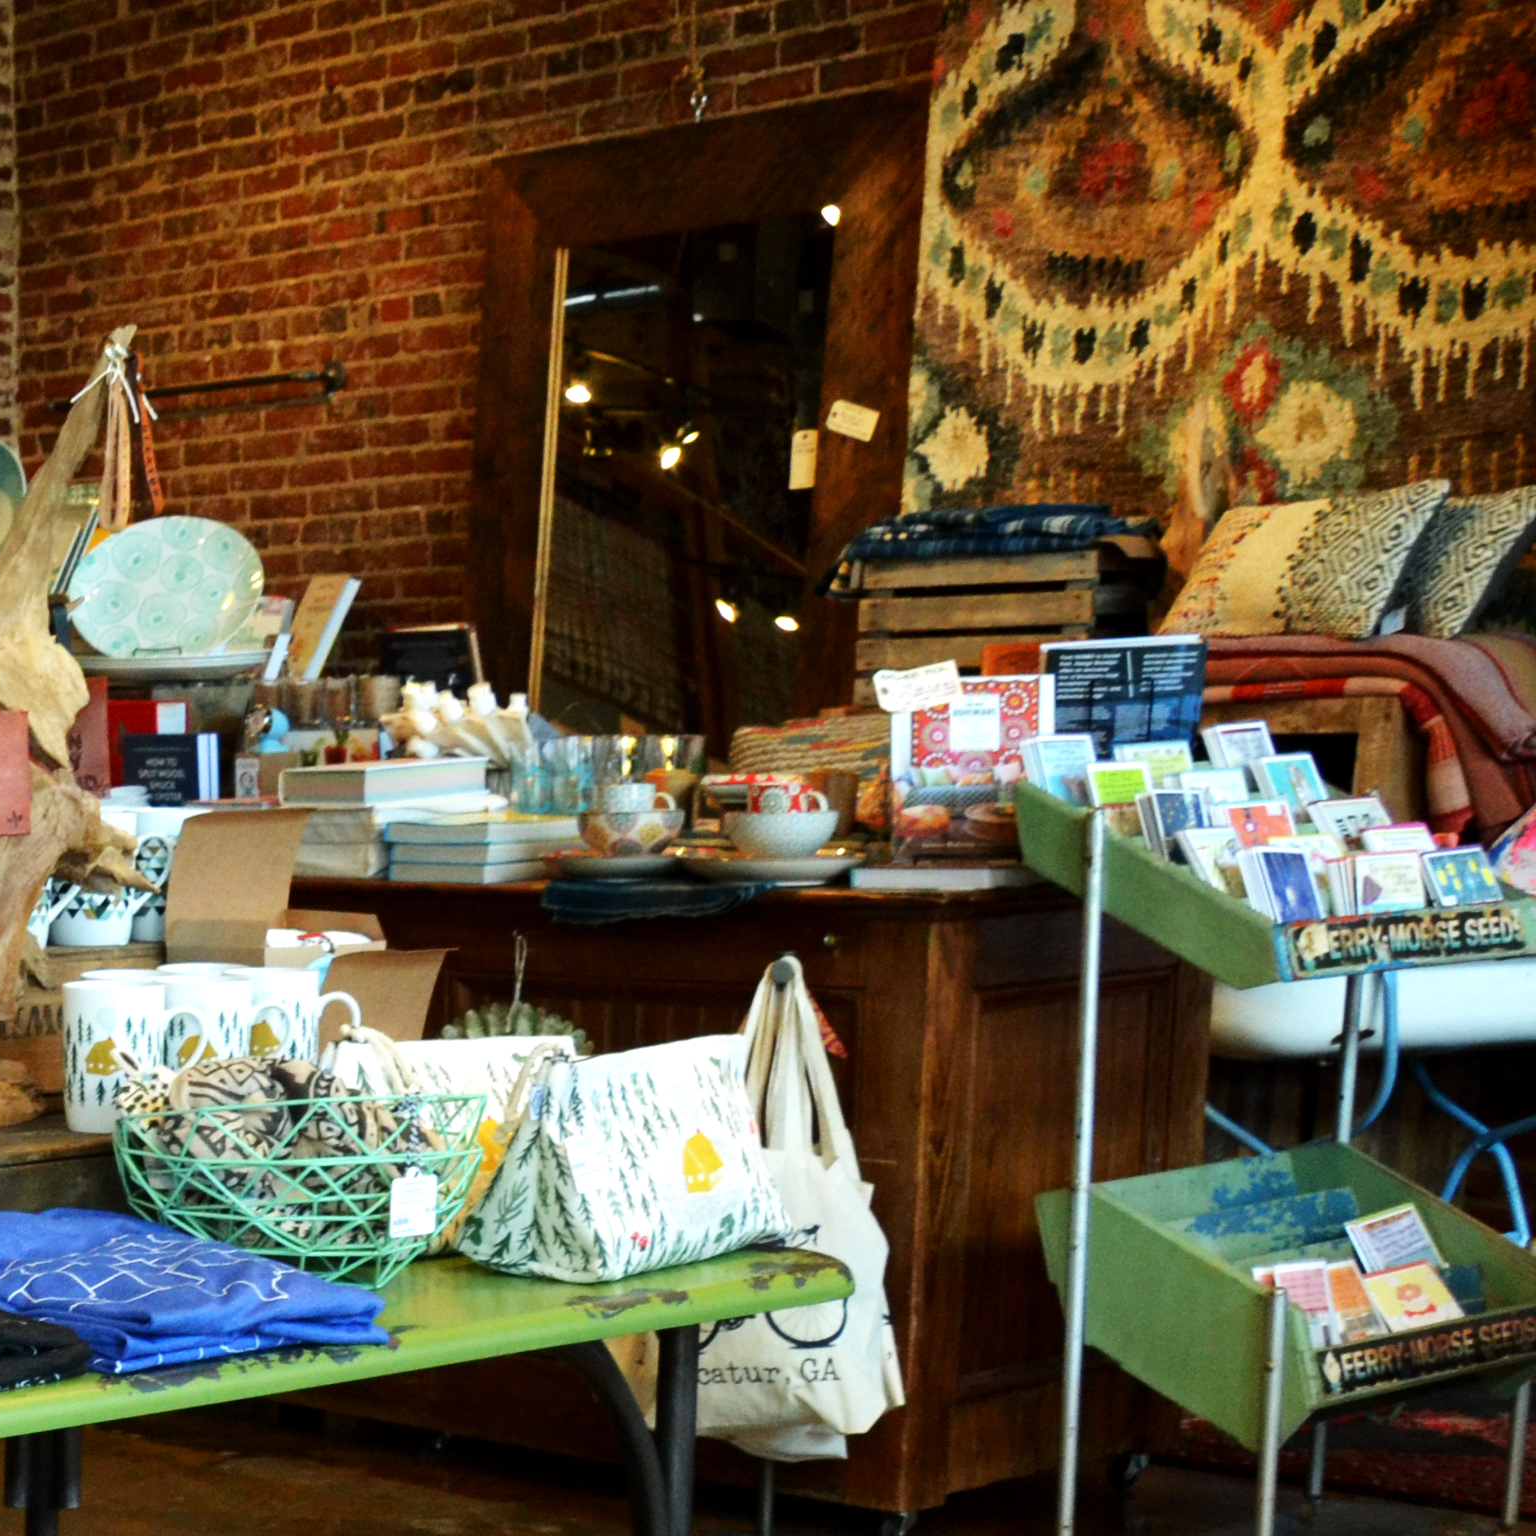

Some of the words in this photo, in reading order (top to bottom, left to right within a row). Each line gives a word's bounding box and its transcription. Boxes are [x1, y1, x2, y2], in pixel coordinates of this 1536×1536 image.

[1324, 916, 1463, 961] ERRY-MORSE
[696, 1360, 791, 1386] catur,
[799, 1356, 842, 1384] GA
